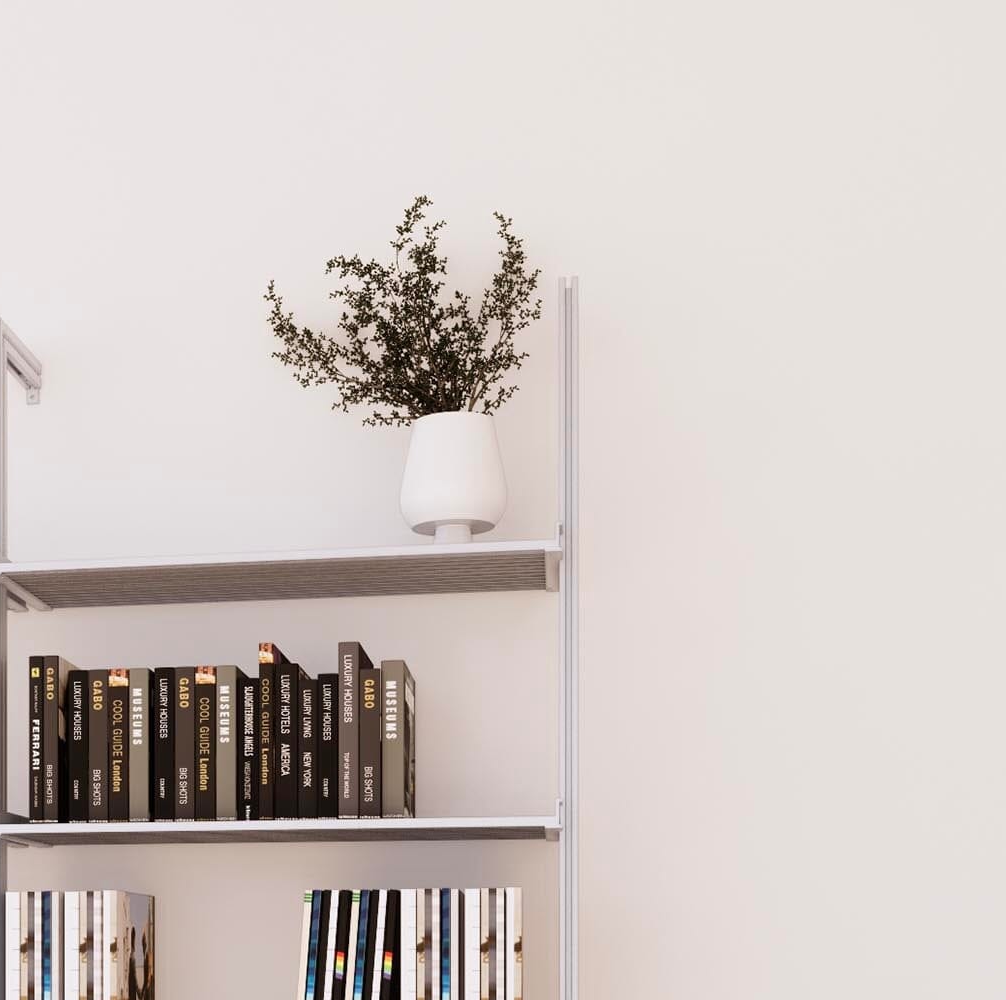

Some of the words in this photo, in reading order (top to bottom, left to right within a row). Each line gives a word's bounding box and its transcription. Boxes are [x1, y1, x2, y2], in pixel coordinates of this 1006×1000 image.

[46, 667, 54, 700] GABO
[343, 654, 352, 687] LUXURY
[73, 681, 81, 709] LUXURY
[93, 680, 103, 710] GABO
[160, 678, 168, 706] LUXURY
[179, 677, 189, 708] GABO
[261, 678, 270, 707] COOL
[280, 674, 290, 700] LUXURY
[323, 684, 331, 711] LUXURY
[364, 680, 374, 708] GABO
[112, 699, 122, 726] COOL
[133, 688, 142, 745] MUSEUMS
[200, 697, 210, 723] COOL
[220, 686, 230, 744] MUSEUMS
[303, 689, 311, 715] LUXURY
[343, 689, 352, 723] HOUSES
[386, 681, 396, 740] MUSEUMS
[73, 711, 81, 741] HOUSES
[160, 708, 168, 738] HOUSES
[261, 712, 270, 744] GUIDE
[280, 702, 290, 734] HOTELS
[303, 717, 311, 738] LIVING
[323, 712, 331, 741] HOUSES
[32, 719, 40, 770] FERRARI
[112, 728, 122, 757] GUIDE
[200, 726, 210, 755] GUIDE
[244, 736, 253, 757] ANGELS
[46, 764, 54, 777] BIG
[179, 768, 187, 779] BIG
[261, 748, 270, 785] London
[280, 743, 290, 776] AMERICA
[303, 752, 311, 768] NEW
[364, 766, 373, 778] BIG
[93, 769, 101, 781] BIG
[112, 760, 122, 792] London
[200, 758, 210, 791] London
[303, 769, 311, 787] YORK
[46, 779, 54, 804] SHOTS
[93, 783, 101, 806] SHOTS
[179, 781, 187, 804] SHOTS
[364, 779, 373, 802] SHOTS
